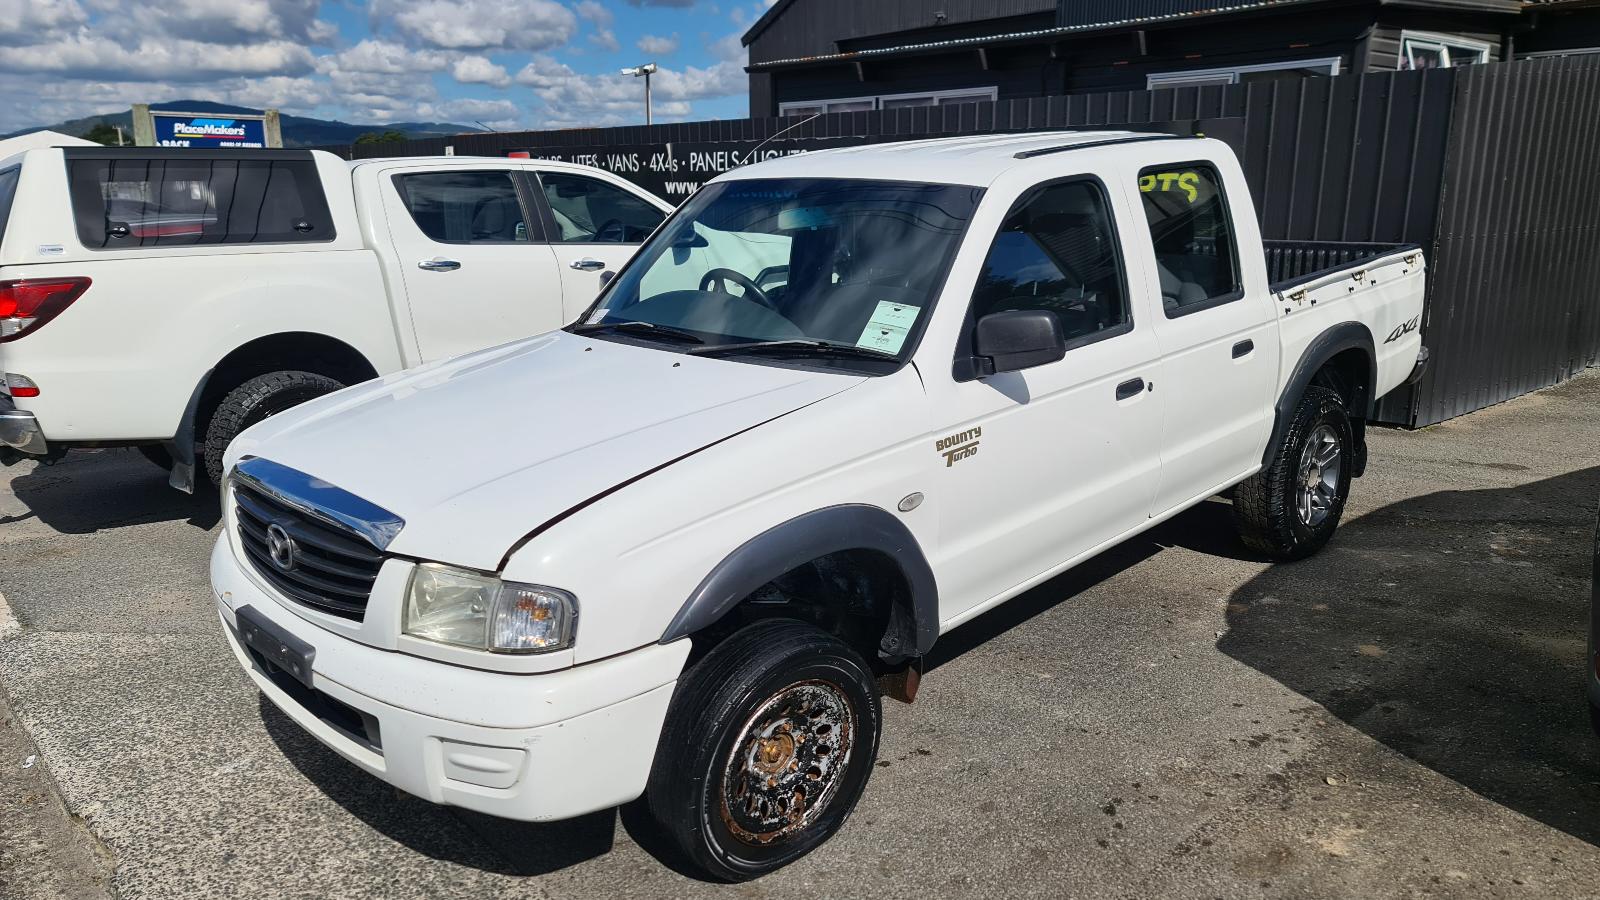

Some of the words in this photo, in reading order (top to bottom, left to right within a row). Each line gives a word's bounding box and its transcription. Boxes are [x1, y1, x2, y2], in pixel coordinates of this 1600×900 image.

[174, 123, 245, 135] PlaceMakers
[607, 153, 640, 172] VANS
[690, 151, 740, 172] PANELS
